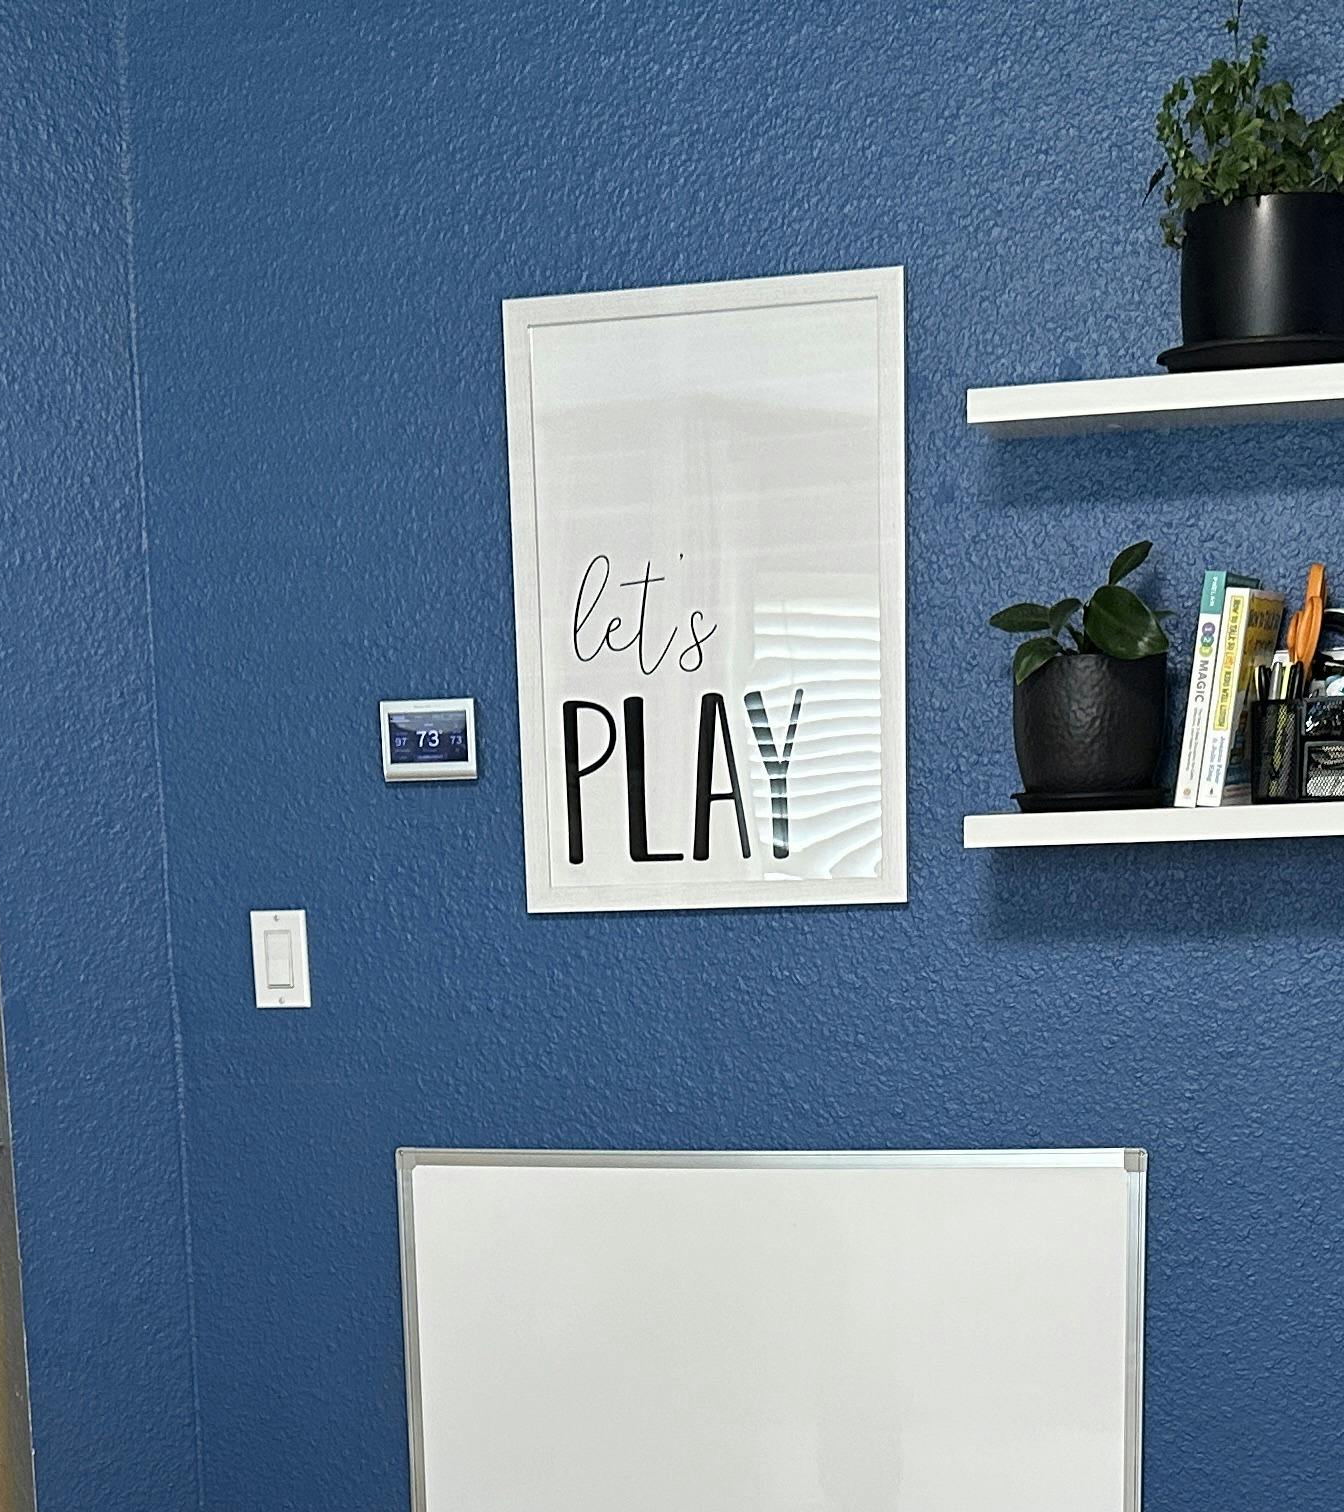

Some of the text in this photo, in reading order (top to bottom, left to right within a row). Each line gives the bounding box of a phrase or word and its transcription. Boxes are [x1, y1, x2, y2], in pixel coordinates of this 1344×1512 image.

[574, 553, 717, 675] let's
[1195, 660, 1209, 703] MAGIC
[563, 688, 804, 864] PLAY
